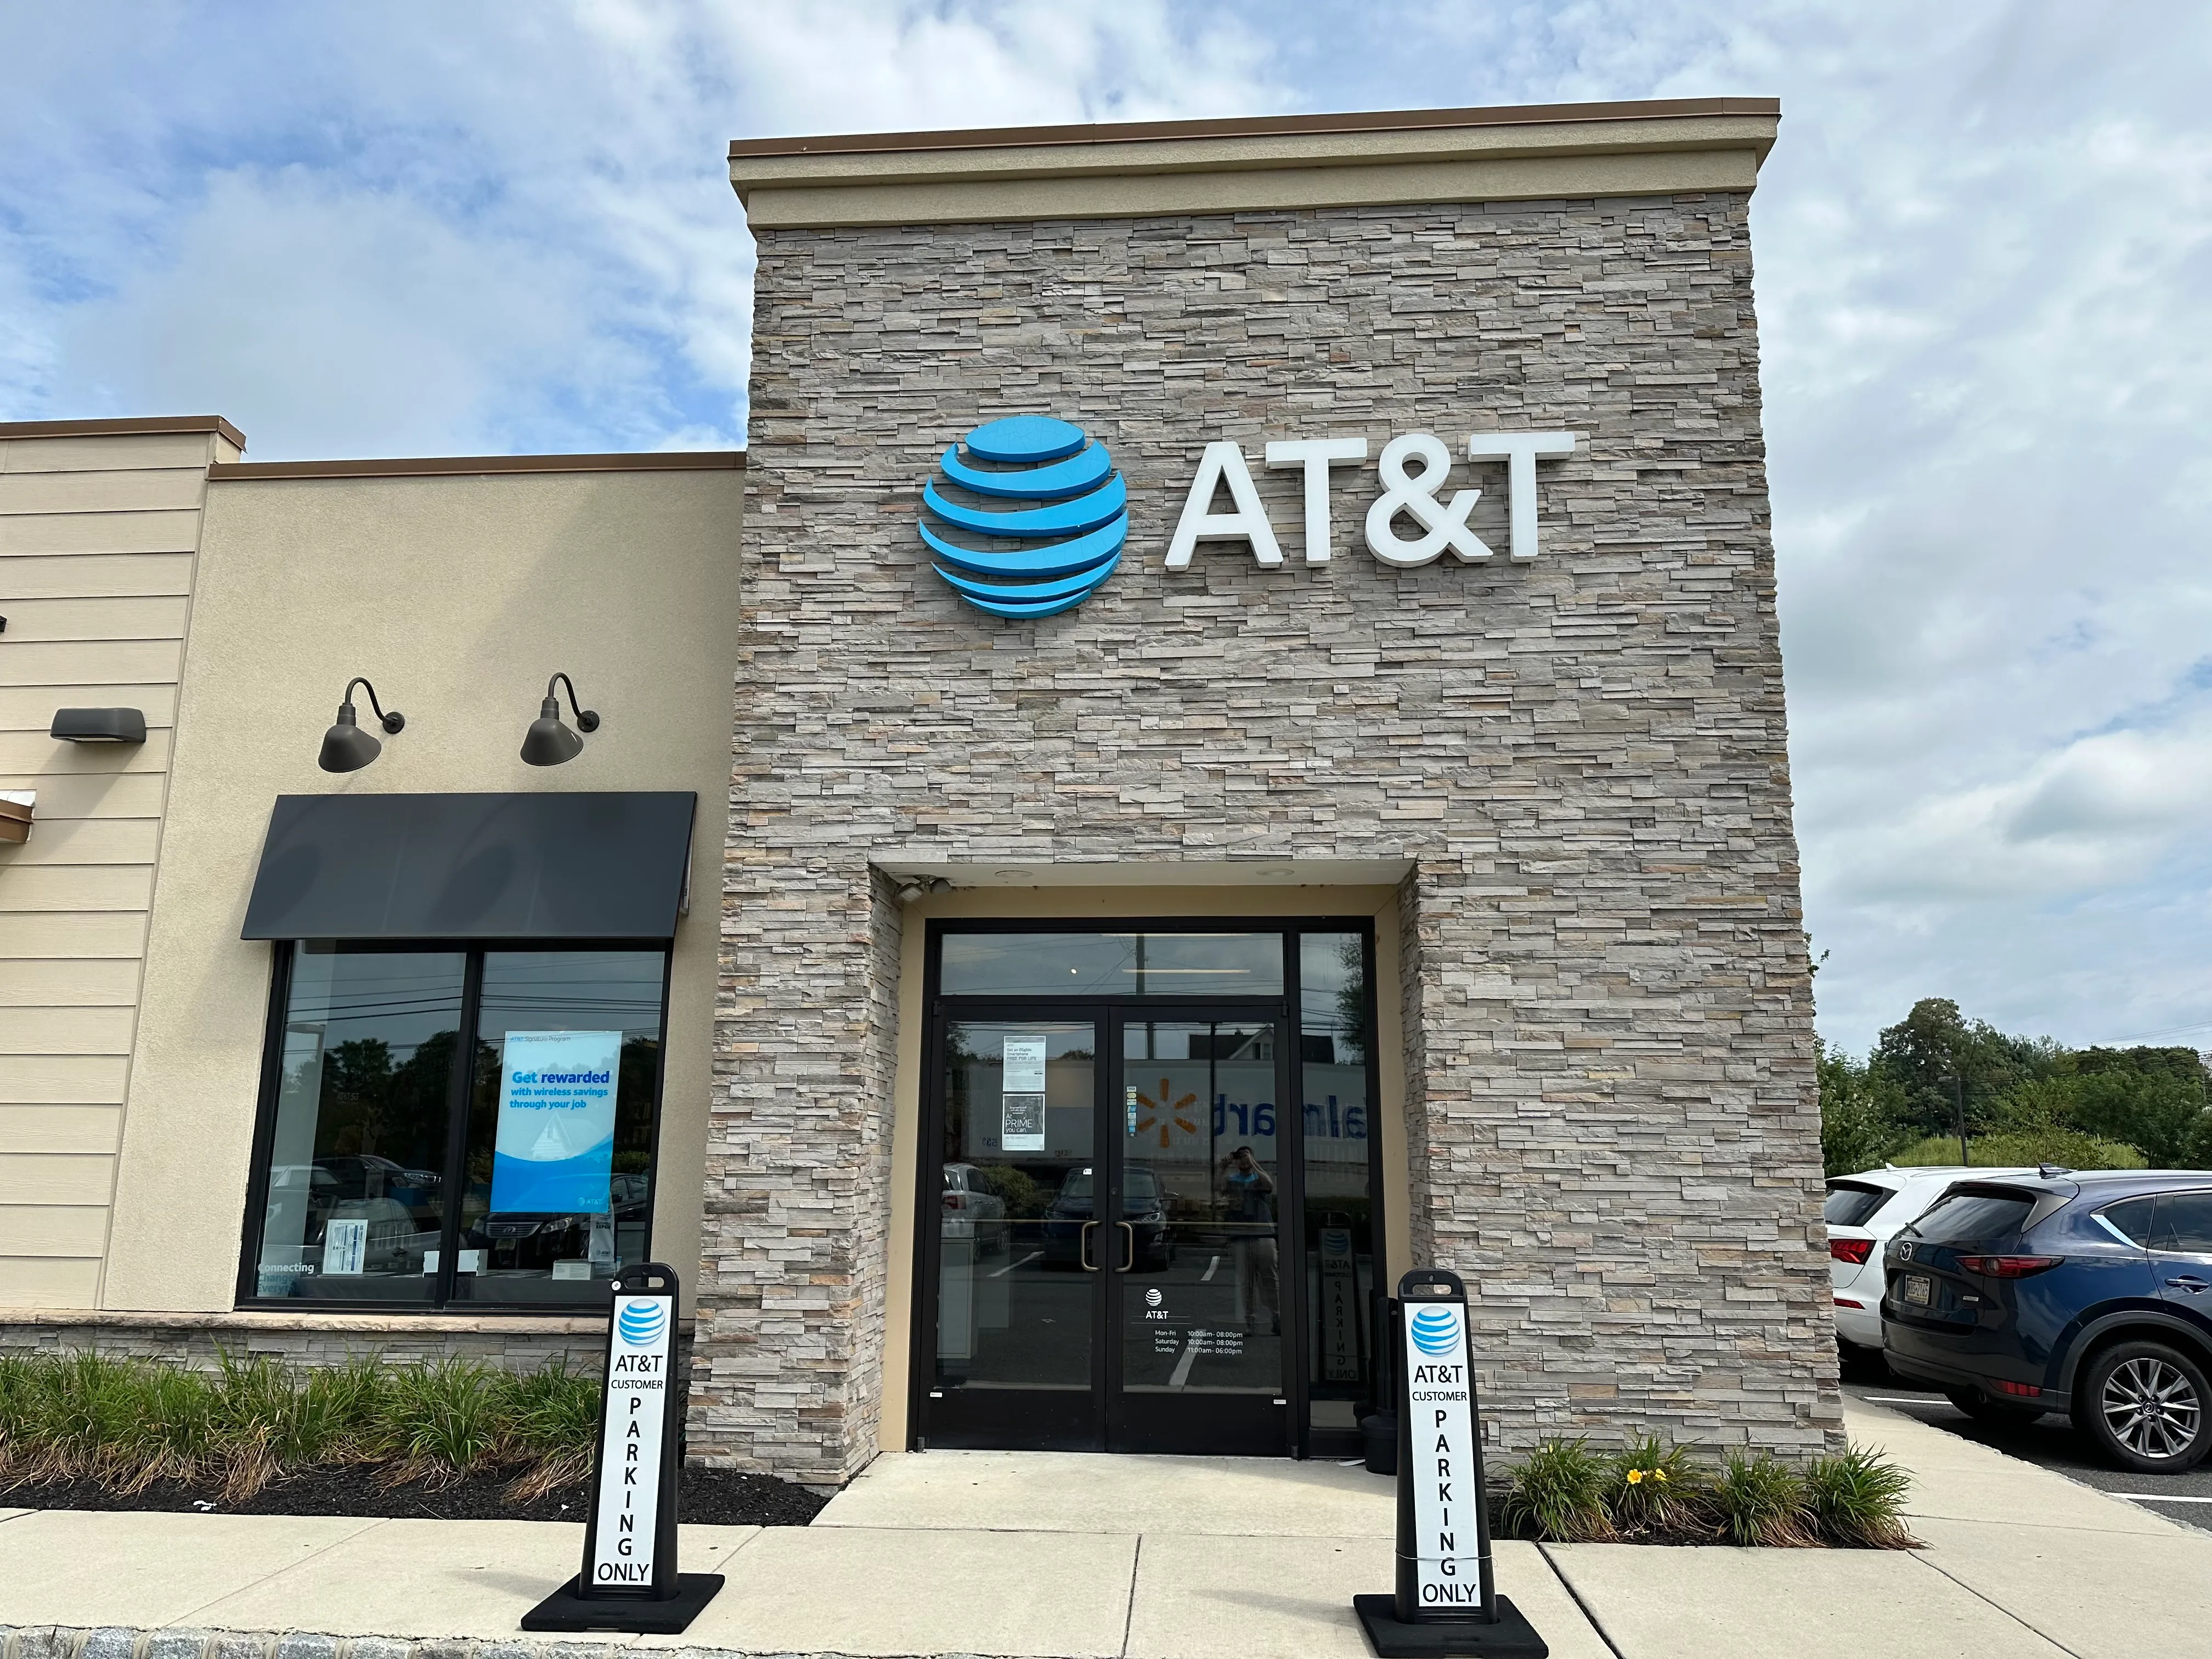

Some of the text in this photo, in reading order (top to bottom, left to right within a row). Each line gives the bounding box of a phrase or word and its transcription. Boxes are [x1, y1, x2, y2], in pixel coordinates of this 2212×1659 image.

[1164, 431, 1576, 572] AT&T
[512, 1070, 610, 1084] Get rewarded
[511, 1087, 608, 1097] with wireless savings
[509, 1099, 586, 1110] through your job
[1005, 1119, 1033, 1128] PRIME
[258, 1262, 314, 1274] Connecting
[1146, 1311, 1169, 1319] AT&T
[615, 1355, 663, 1372] AT&T
[1414, 1365, 1463, 1384] AT&T
[611, 1380, 663, 1390] CUSTOMER
[1412, 1391, 1468, 1401] CUSTOMER
[618, 1397, 641, 1556] PARKING
[1435, 1409, 1456, 1576] PARKING
[598, 1563, 650, 1581] ONLY
[1423, 1584, 1477, 1602] ONLY
